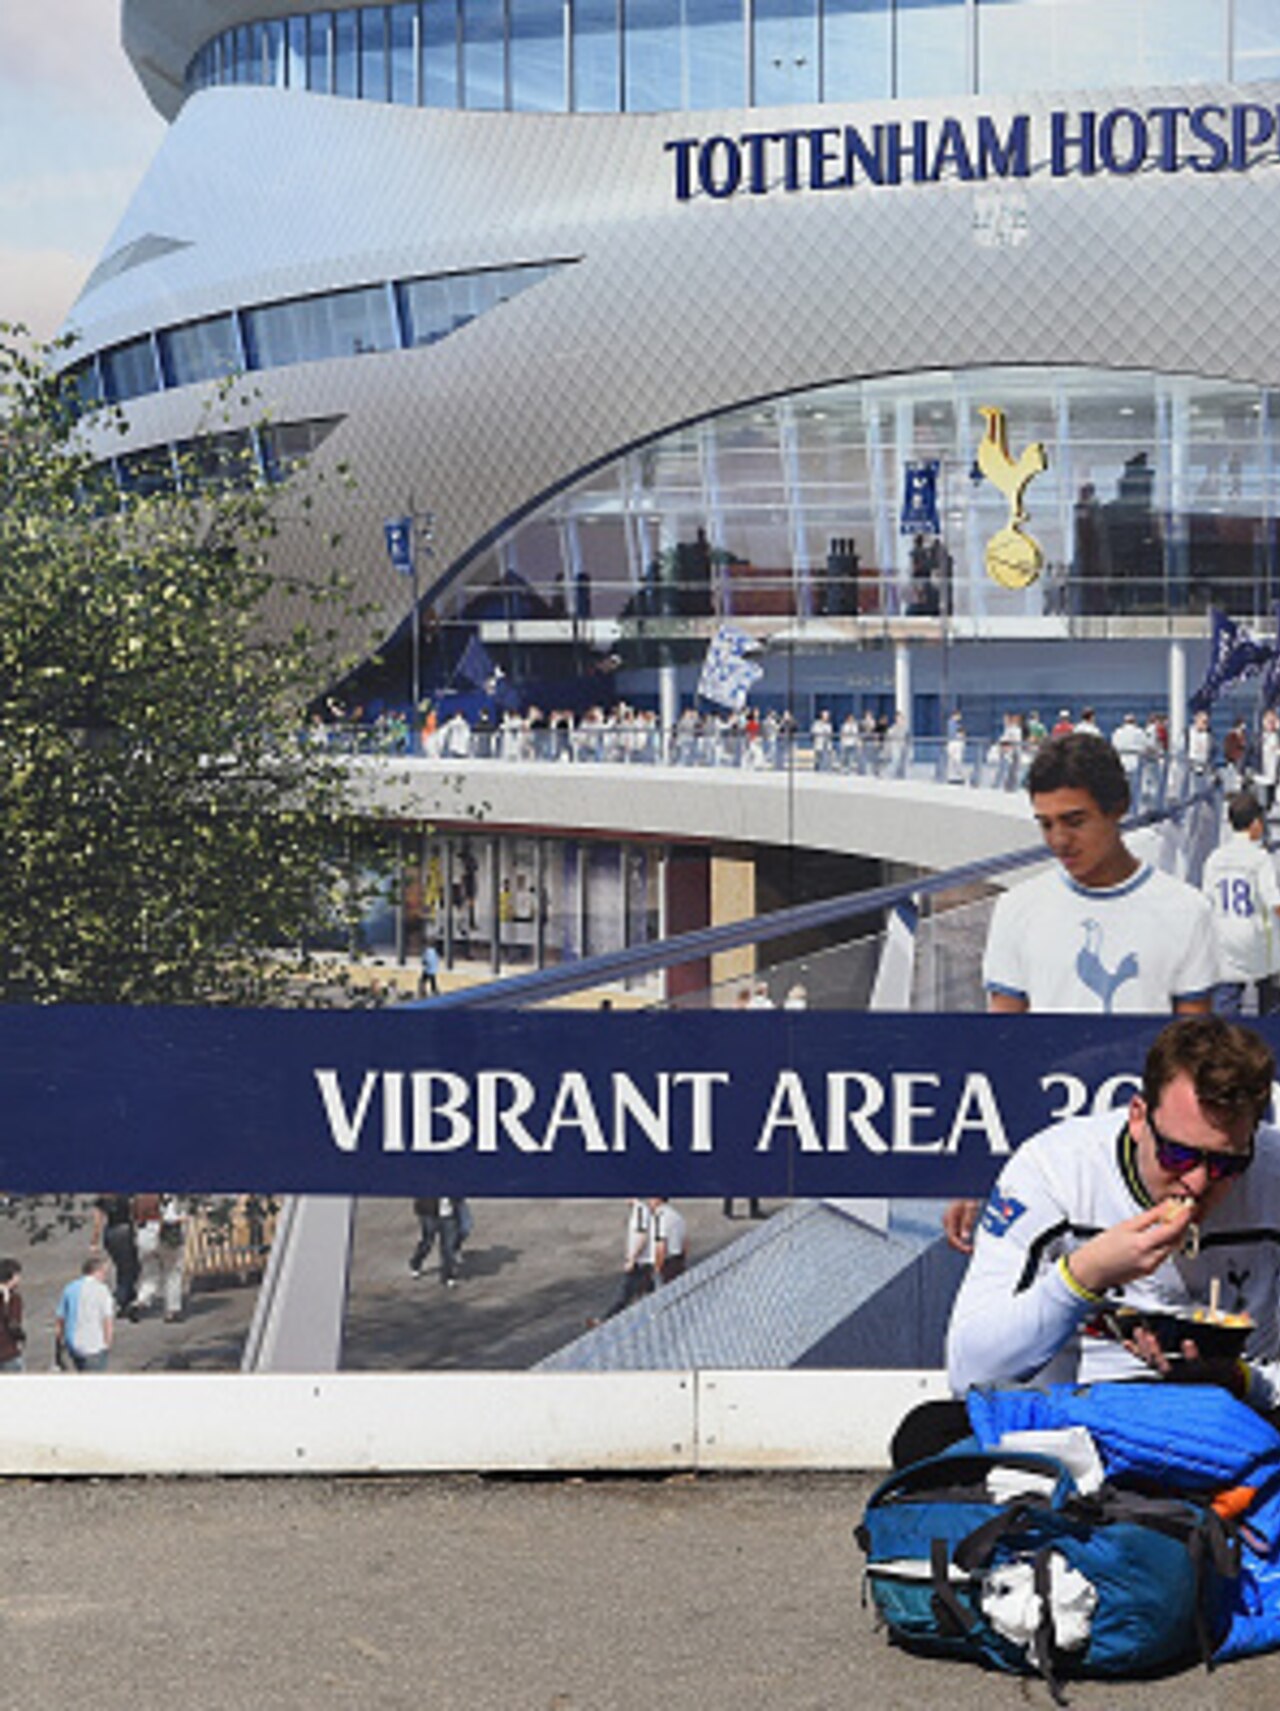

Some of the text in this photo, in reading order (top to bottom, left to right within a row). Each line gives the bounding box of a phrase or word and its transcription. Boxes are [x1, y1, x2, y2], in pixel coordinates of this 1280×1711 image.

[663, 113, 1031, 202] TOTTENHAM
[1214, 878, 1255, 918] 18
[314, 1070, 730, 1153] VIBRANT
[755, 1071, 1012, 1155] AREA
